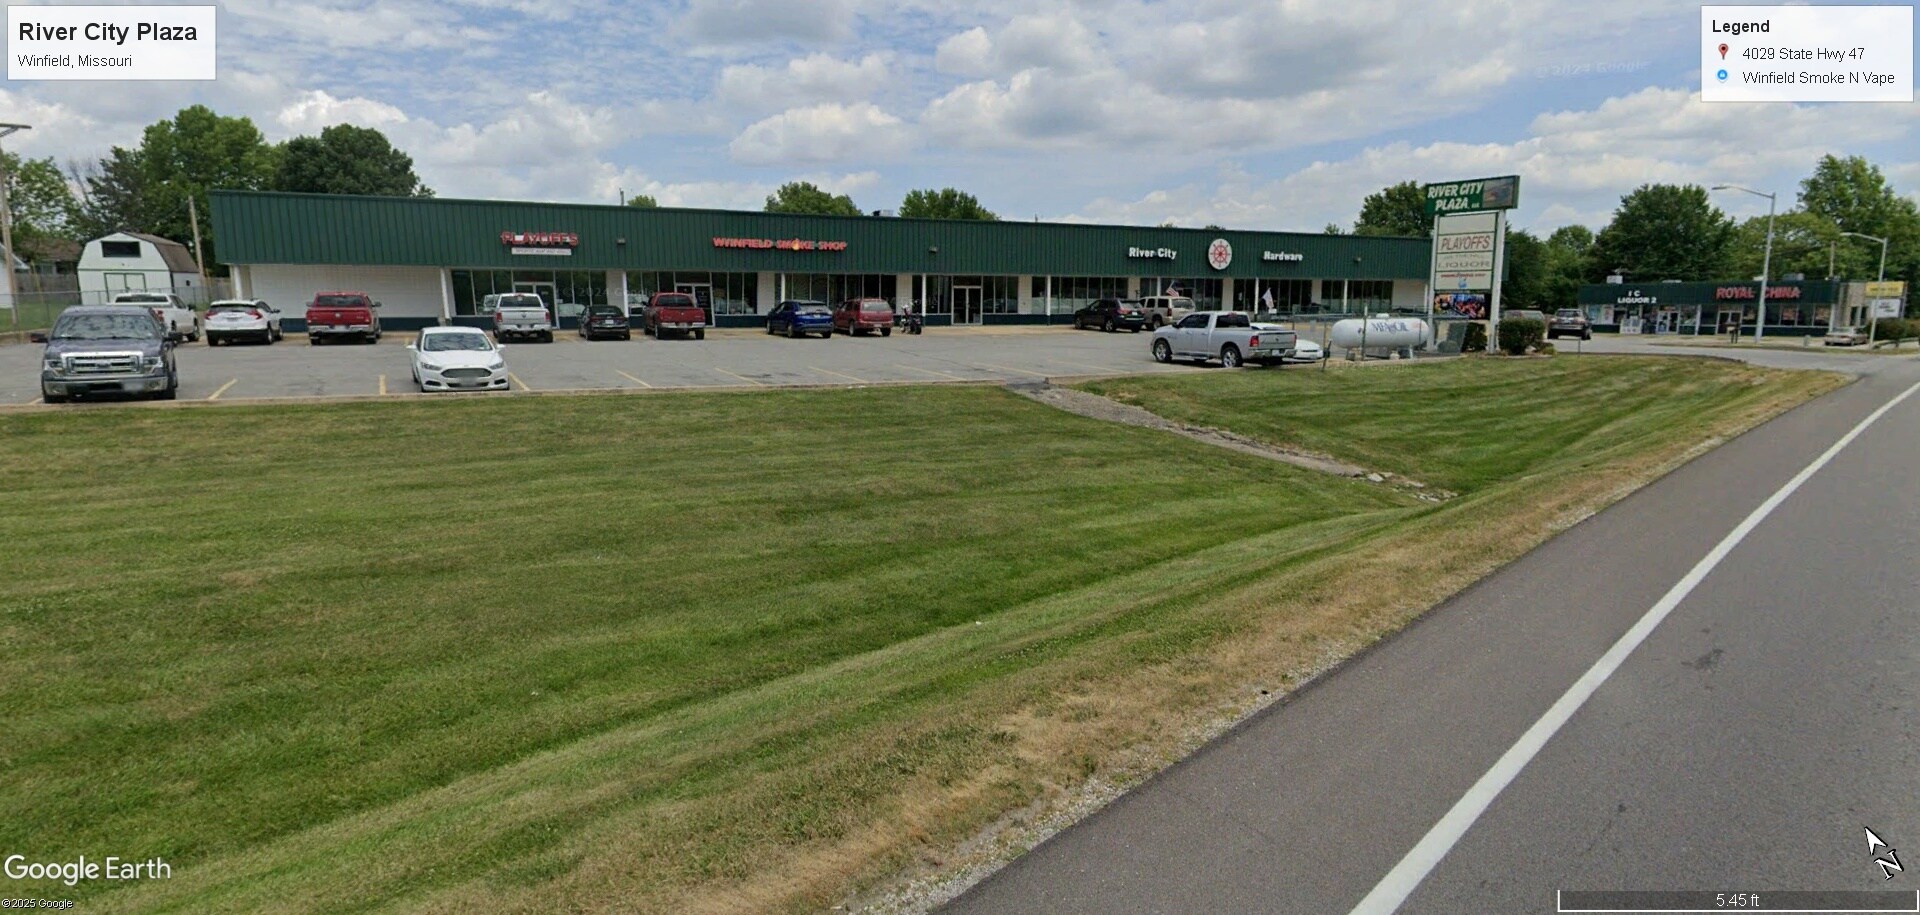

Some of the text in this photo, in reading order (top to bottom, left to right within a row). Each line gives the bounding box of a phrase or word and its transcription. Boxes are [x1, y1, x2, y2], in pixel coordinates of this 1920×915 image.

[1427, 181, 1484, 199] RIVER CITY
[500, 231, 579, 246] PLAYOFFS
[712, 237, 848, 251] WINFIELD SMOKE SHOP
[1440, 235, 1491, 251] PLAYOFFS
[1128, 247, 1303, 262] River City Hardware
[1438, 260, 1490, 268] LIQUOR
[1617, 296, 1657, 304] LIQUOR 2
[1716, 287, 1755, 300] ROYAL
